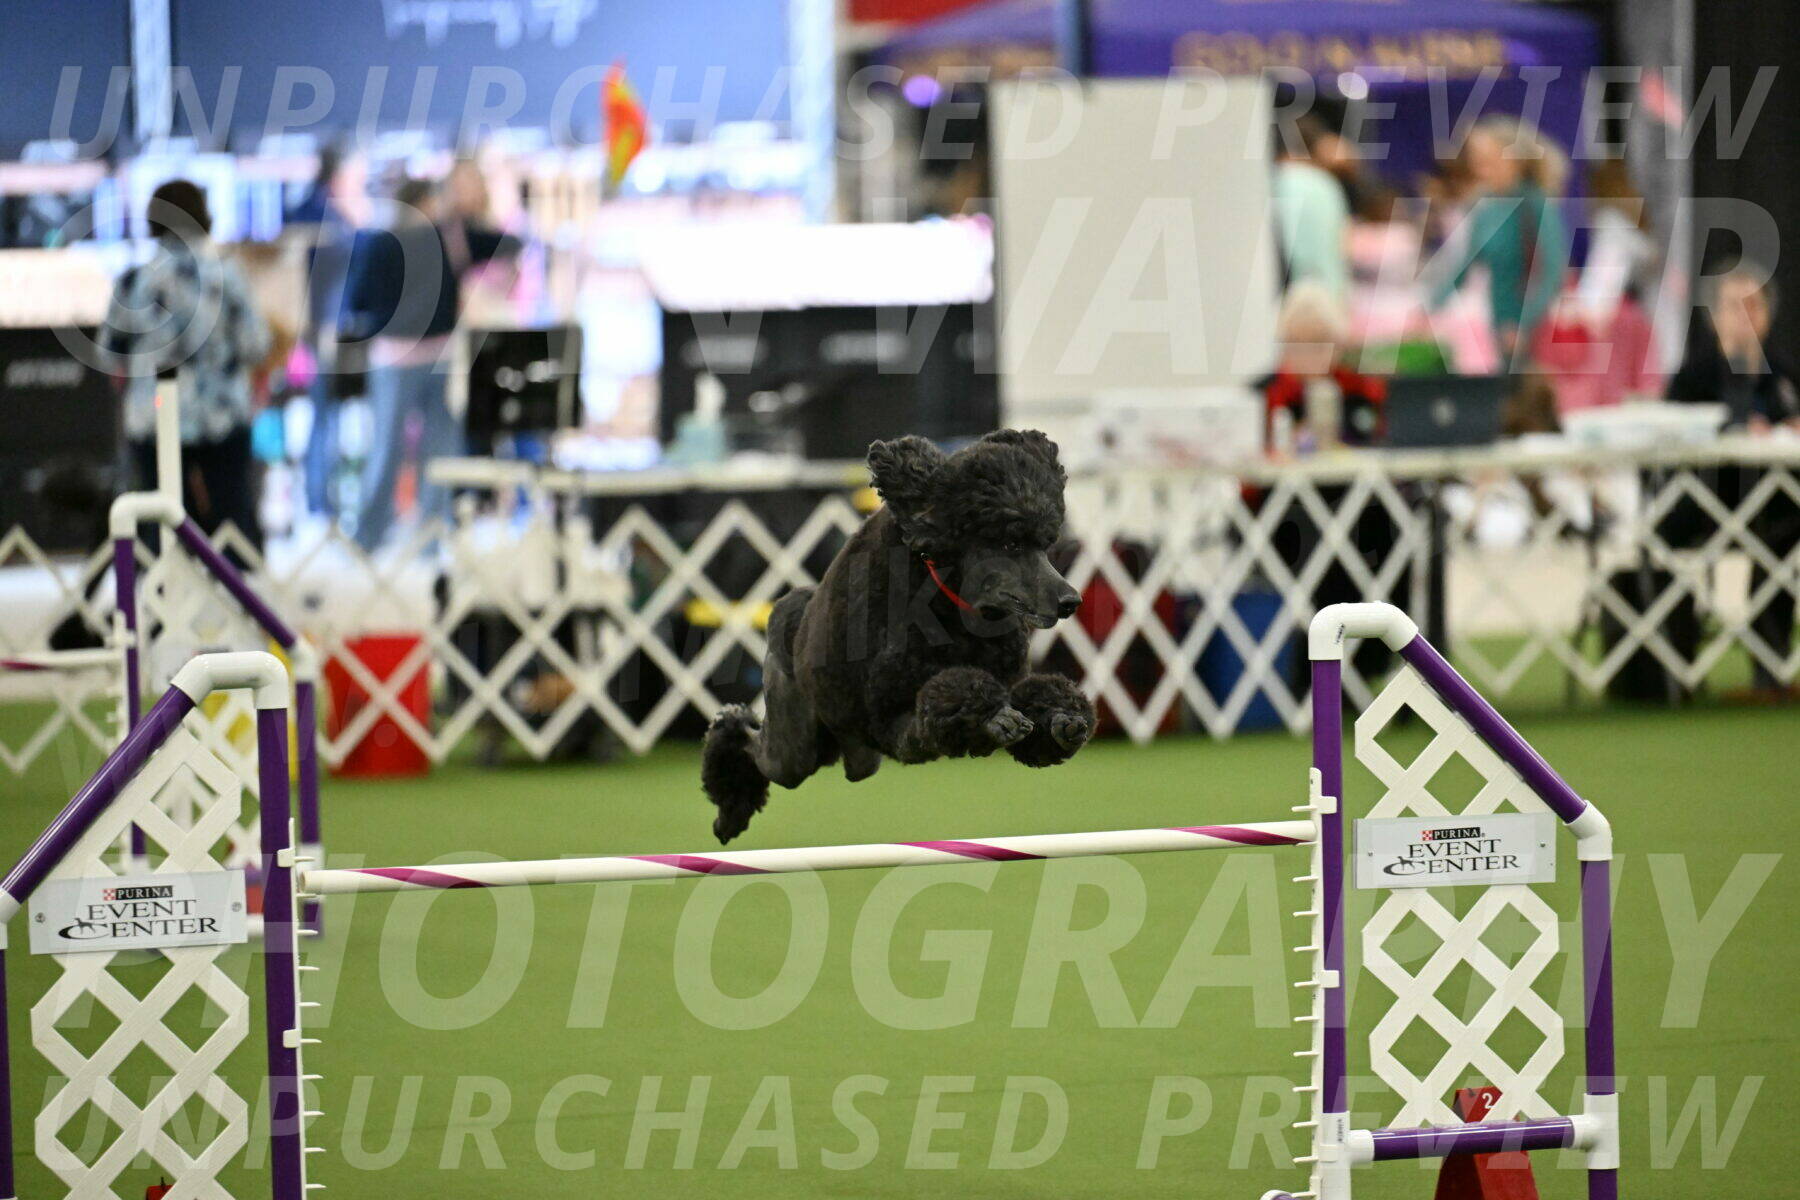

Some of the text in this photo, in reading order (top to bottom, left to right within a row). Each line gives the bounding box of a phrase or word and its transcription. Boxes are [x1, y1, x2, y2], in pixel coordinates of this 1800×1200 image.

[1434, 827, 1479, 840] PURINA
[1408, 838, 1501, 858] EVENT
[1383, 855, 1520, 876] CENTER
[117, 885, 172, 900] PURINA
[86, 899, 197, 921] EVENT
[58, 917, 221, 940] CENTER
[1482, 1092, 1495, 1110] 2
